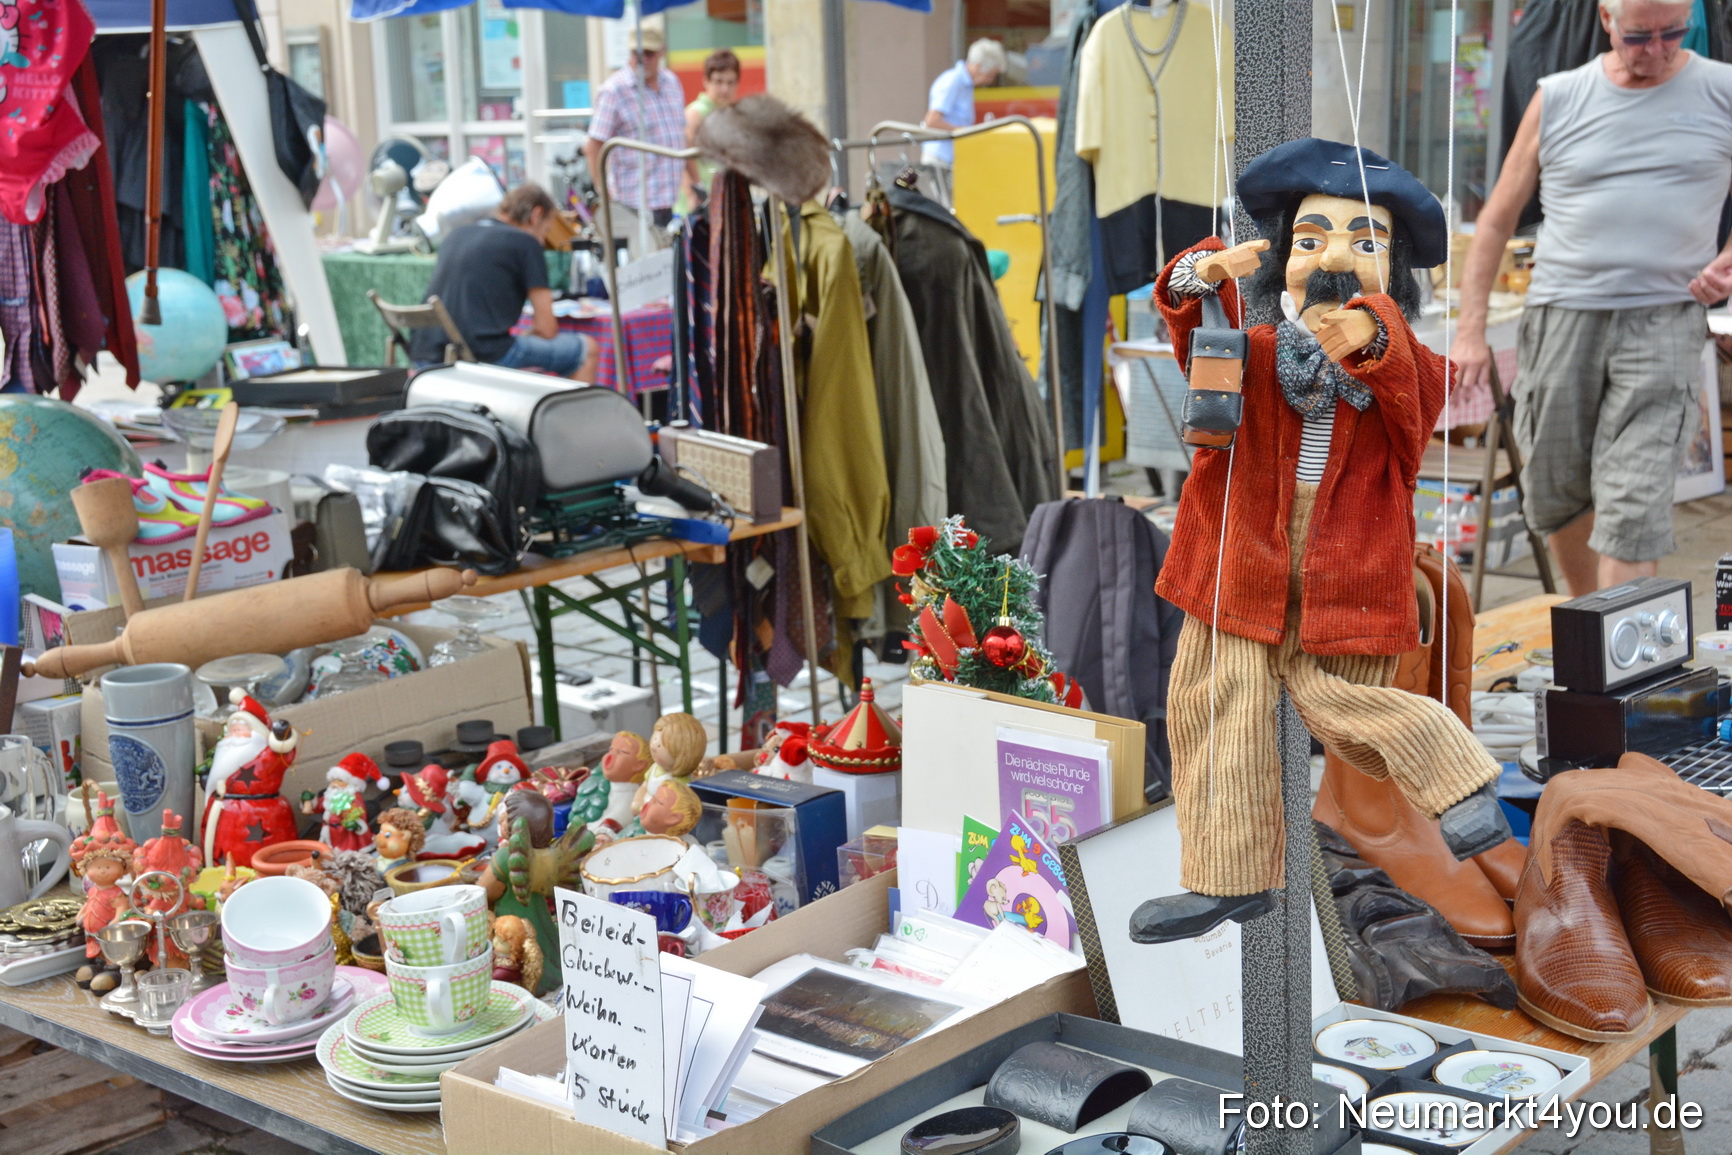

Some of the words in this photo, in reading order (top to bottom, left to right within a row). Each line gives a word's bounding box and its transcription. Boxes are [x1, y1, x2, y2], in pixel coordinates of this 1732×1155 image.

[14, 72, 62, 85] HELLO
[130, 531, 271, 578] massage
[1005, 752, 1021, 768] Die
[1021, 757, 1058, 775] nächste
[1058, 763, 1091, 782] Runde
[1010, 769, 1031, 784] wird
[1031, 772, 1046, 787] viel
[1046, 777, 1085, 795] schöner
[967, 831, 989, 849] ZUM
[1204, 941, 1233, 959] Bavaria
[572, 1072, 590, 1100] 5
